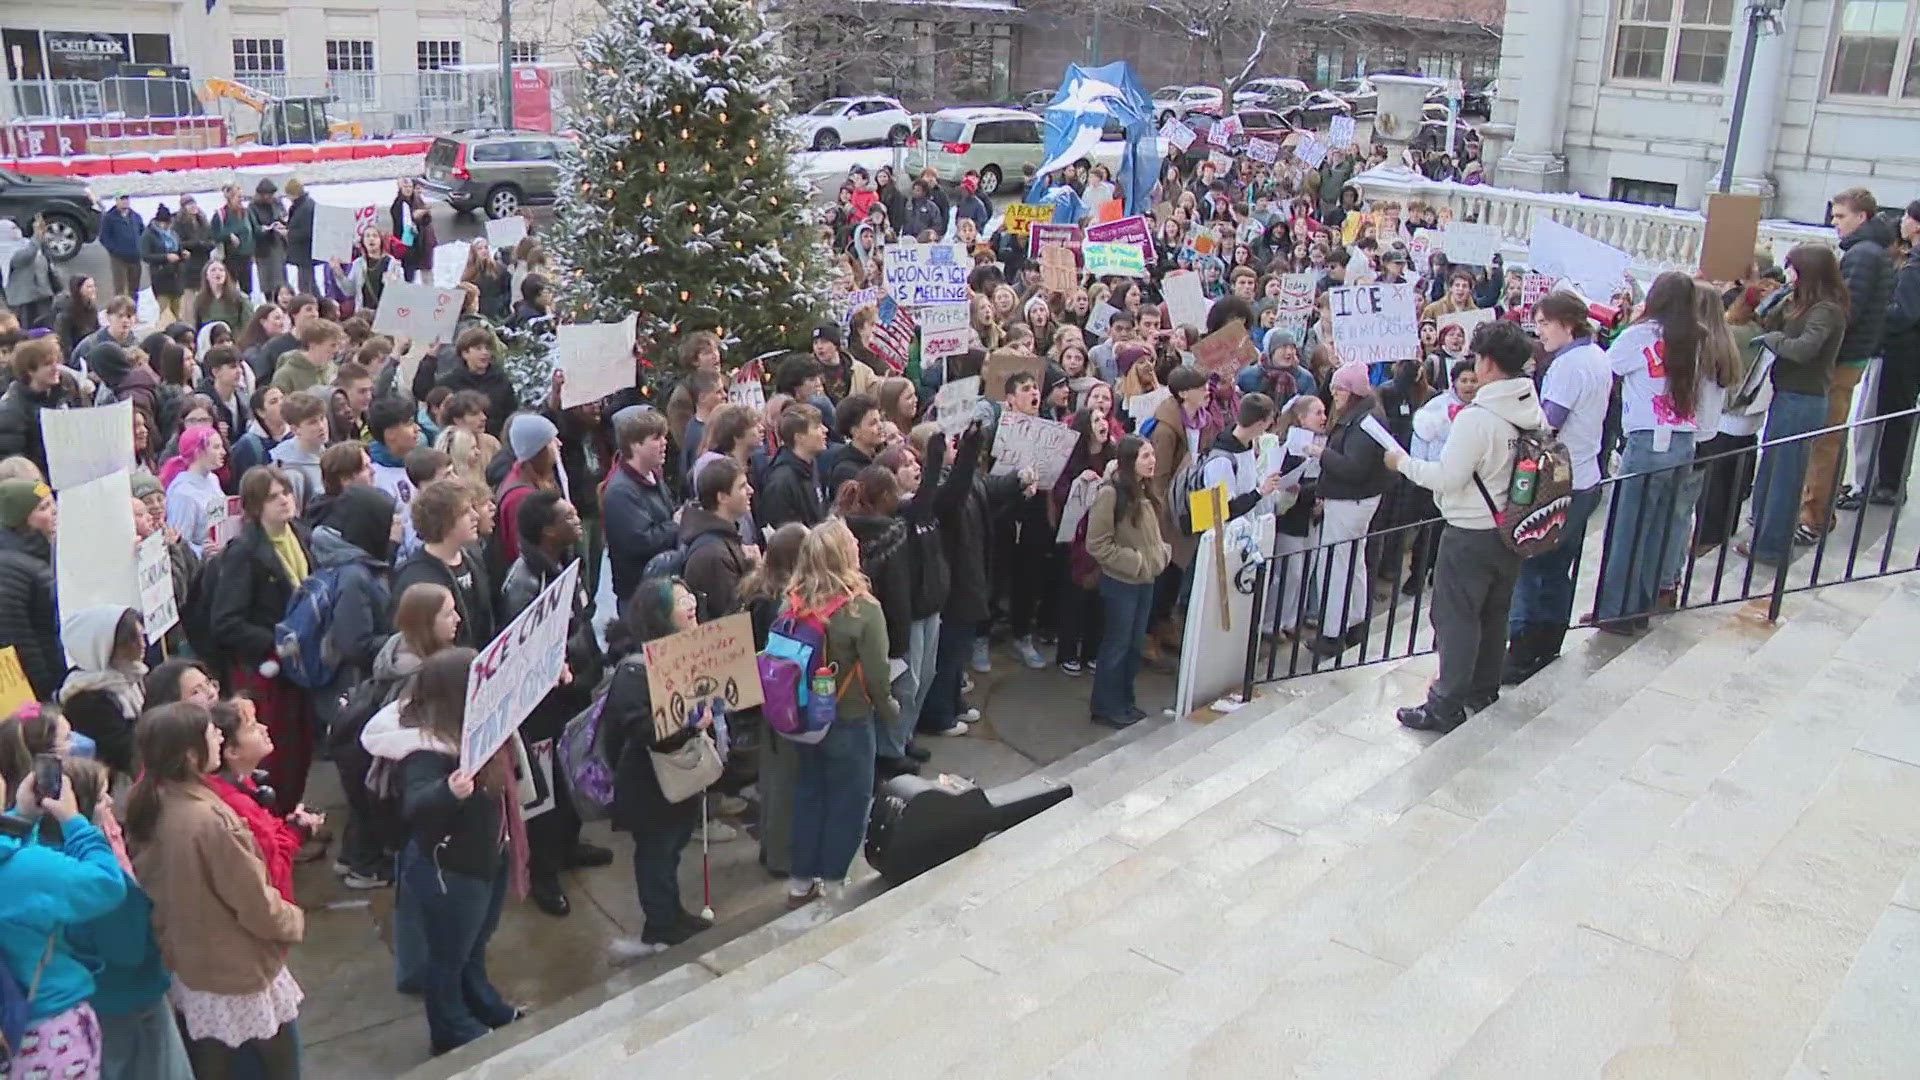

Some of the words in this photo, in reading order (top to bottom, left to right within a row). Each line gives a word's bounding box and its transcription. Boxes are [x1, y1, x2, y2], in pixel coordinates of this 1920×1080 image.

[887, 249, 917, 263] THE
[886, 266, 944, 284] WRONG
[894, 284, 908, 300] IS
[913, 285, 966, 302] MELTING
[1333, 286, 1382, 316] ICE
